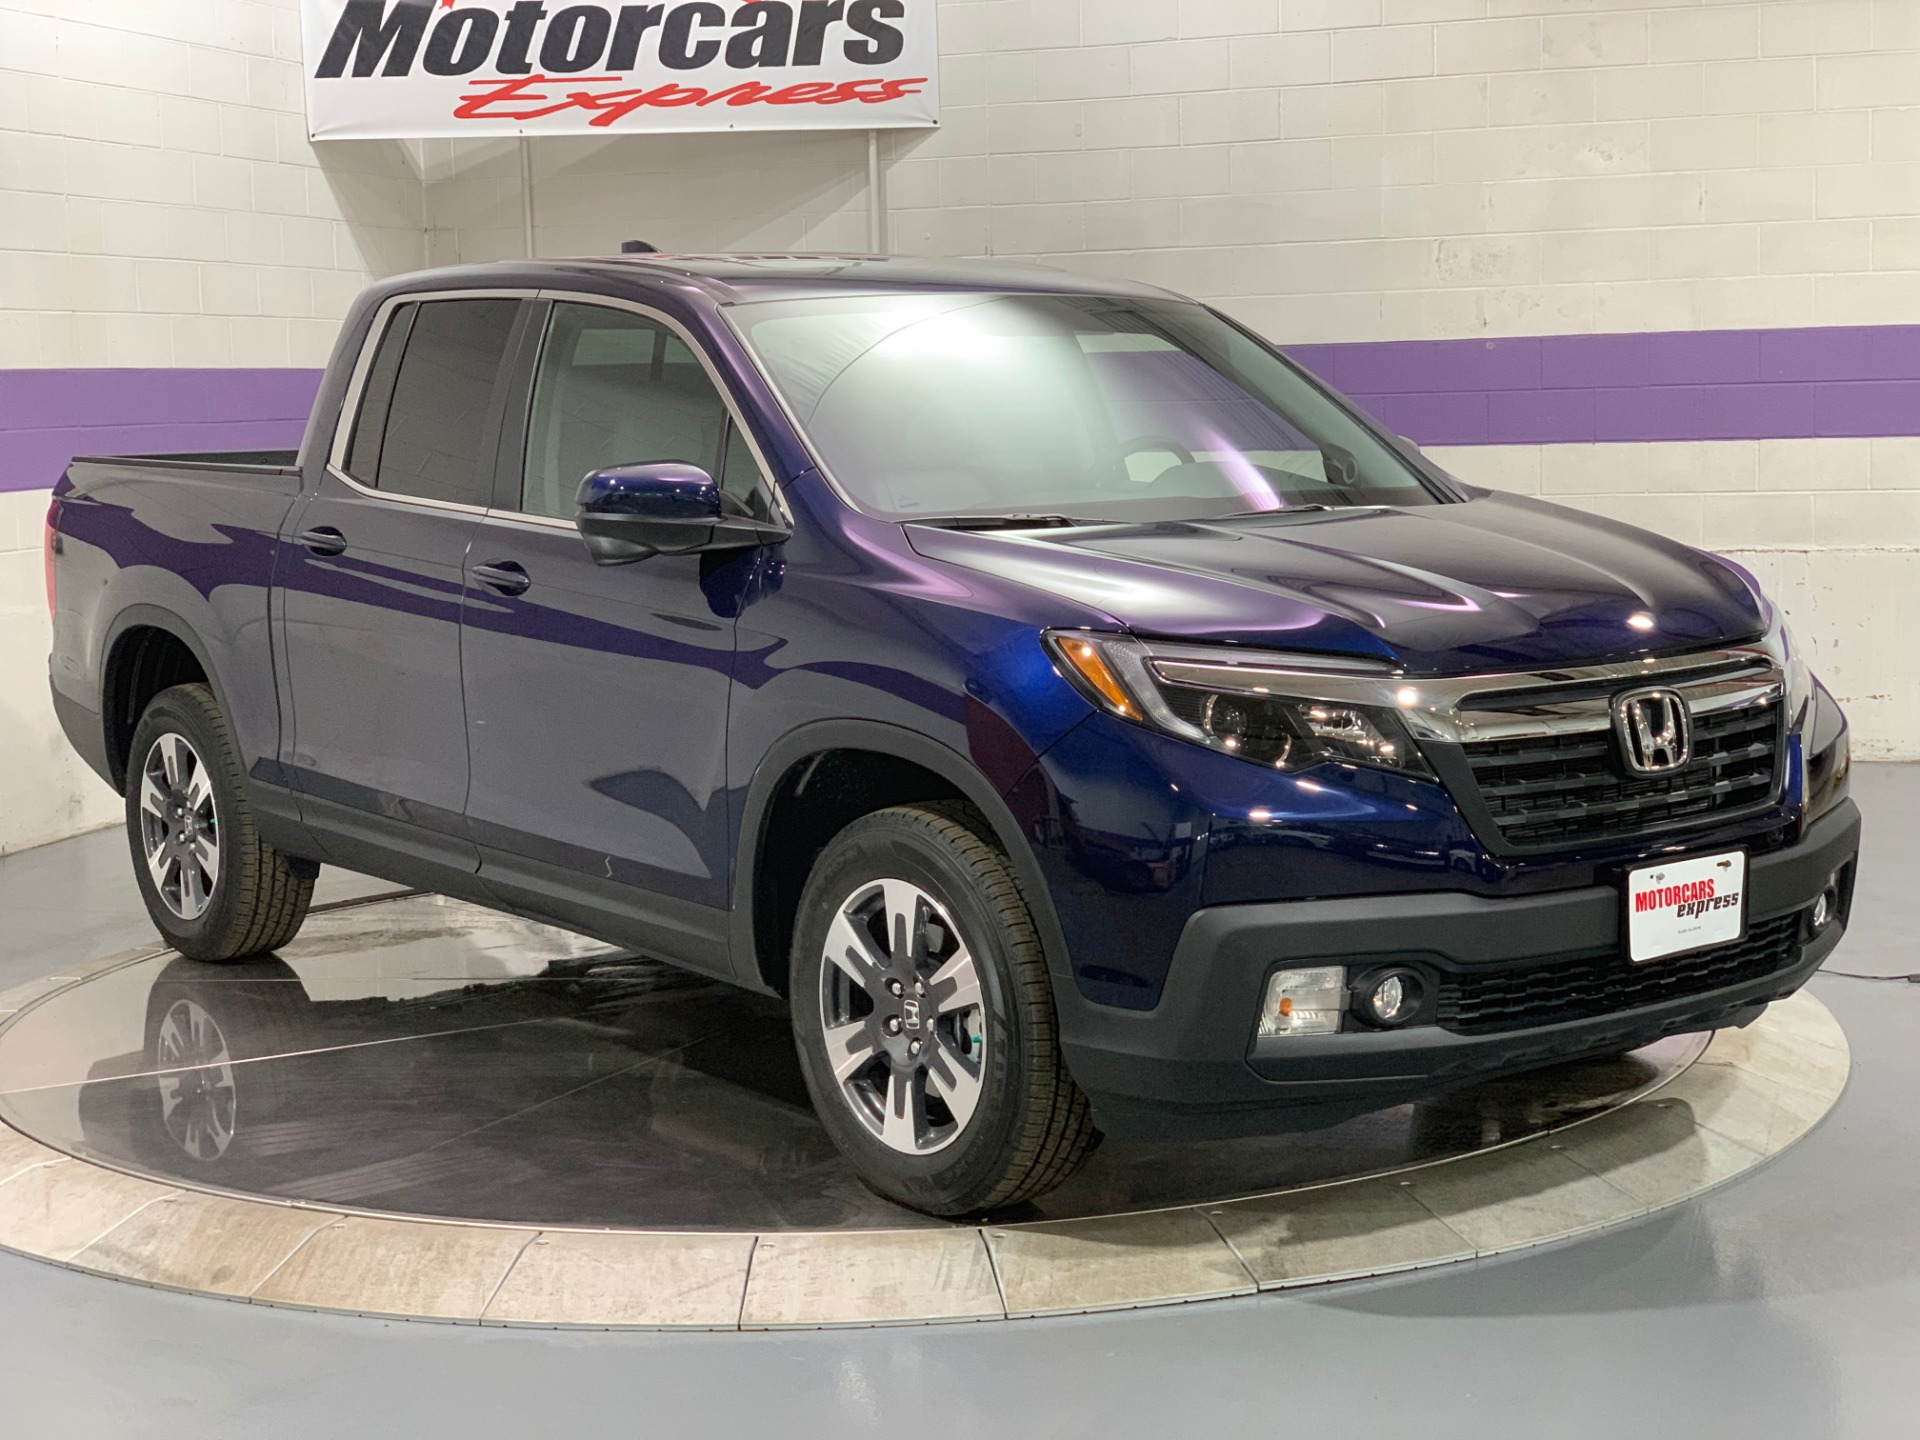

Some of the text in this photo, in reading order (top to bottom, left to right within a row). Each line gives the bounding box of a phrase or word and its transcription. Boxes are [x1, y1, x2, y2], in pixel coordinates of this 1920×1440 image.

[314, 0, 905, 78] Motorcars
[453, 74, 929, 127] Express
[1635, 878, 1715, 912] MOTORCARS
[1677, 892, 1739, 919] express
